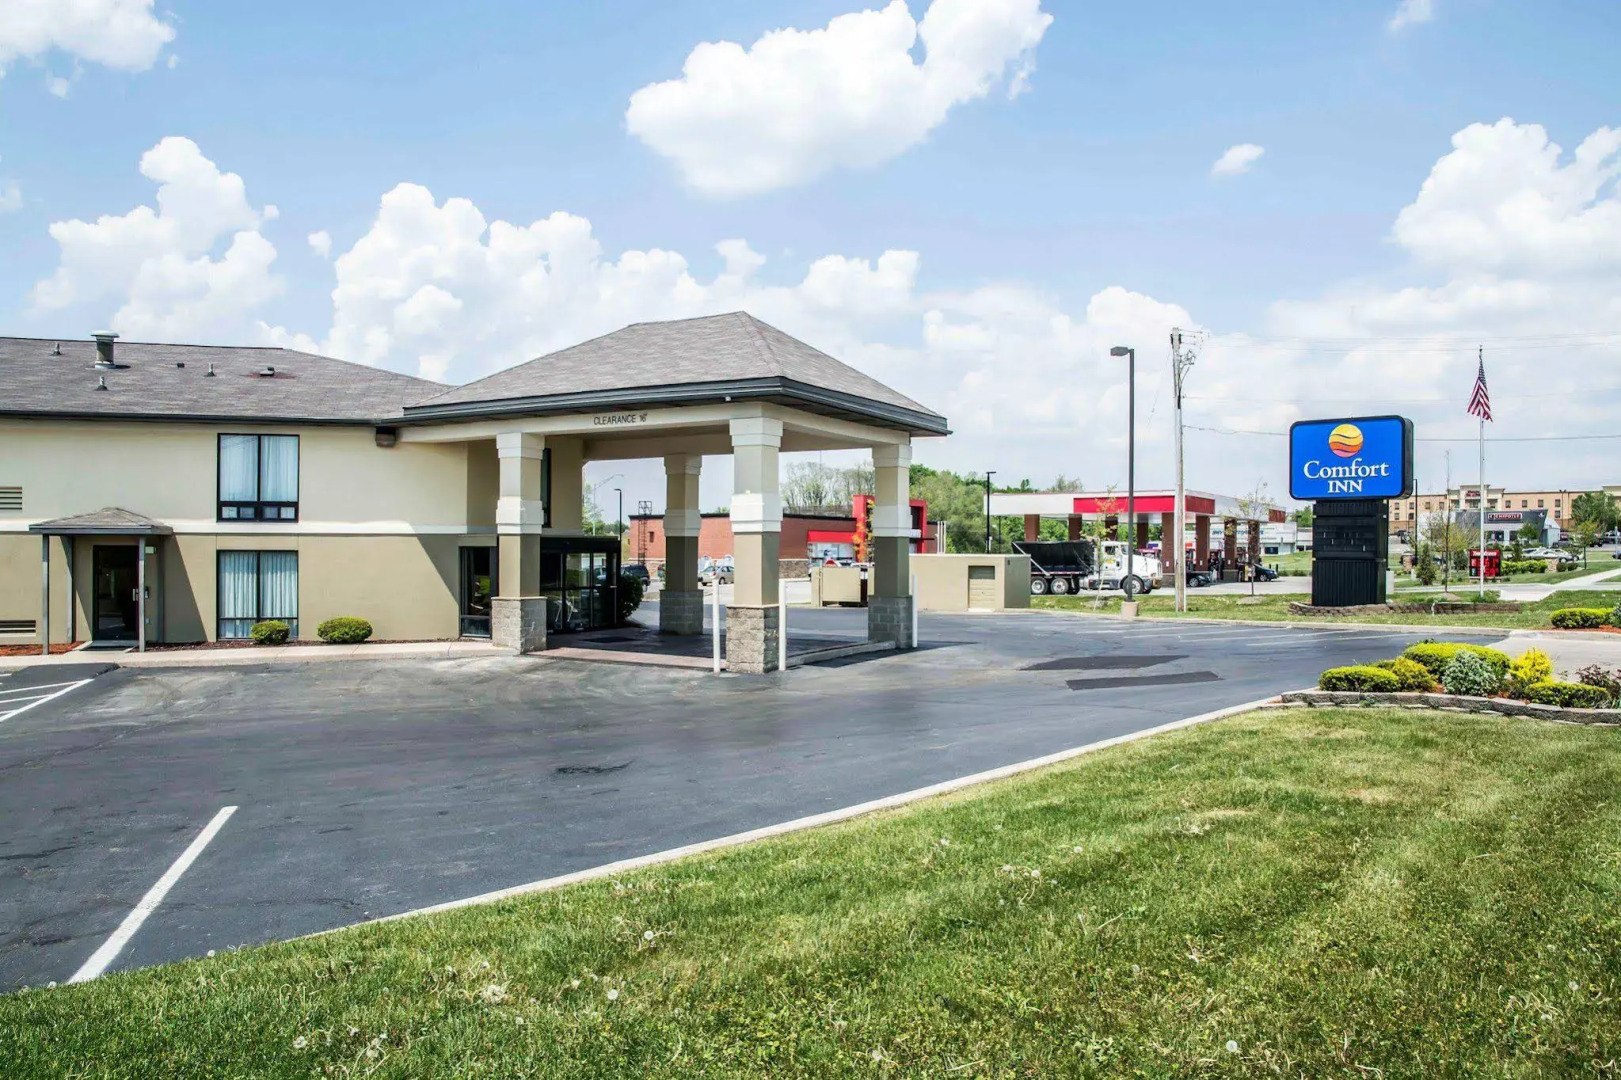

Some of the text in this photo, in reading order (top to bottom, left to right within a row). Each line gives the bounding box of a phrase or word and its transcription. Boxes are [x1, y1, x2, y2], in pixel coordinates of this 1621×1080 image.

[593, 414, 636, 425] CLEARANCE
[1303, 458, 1389, 479] Comfort
[1327, 480, 1363, 494] INN
